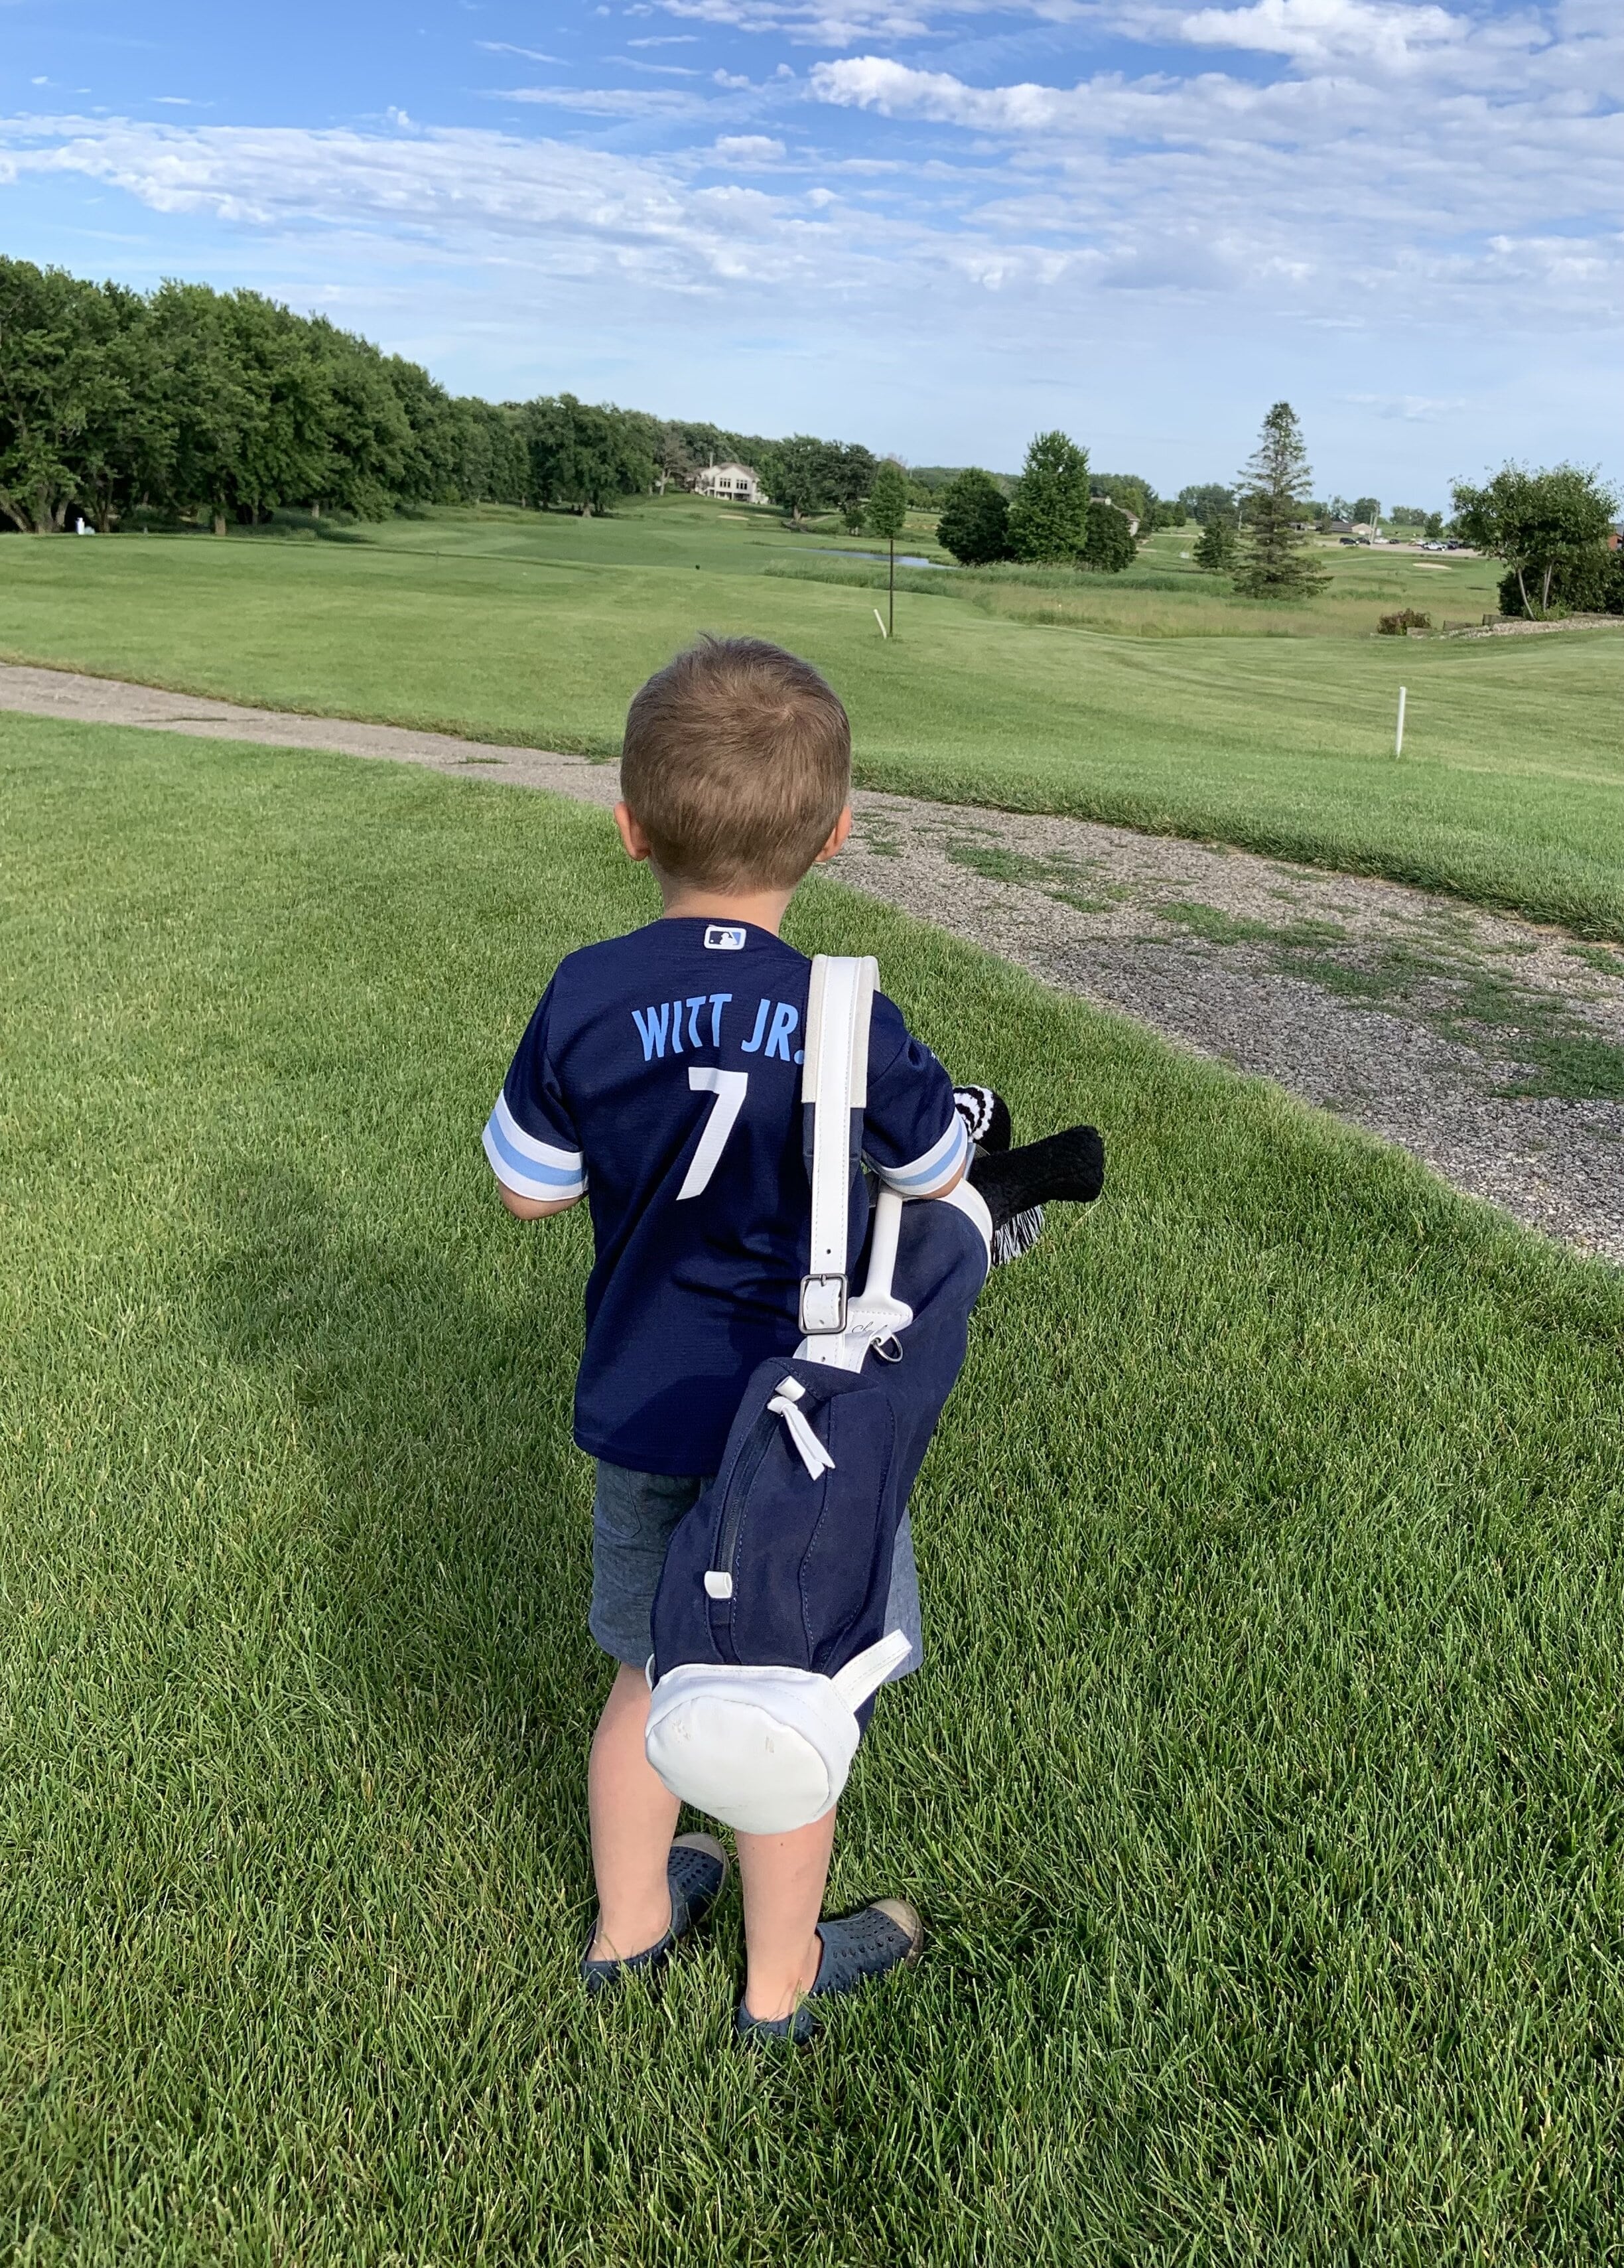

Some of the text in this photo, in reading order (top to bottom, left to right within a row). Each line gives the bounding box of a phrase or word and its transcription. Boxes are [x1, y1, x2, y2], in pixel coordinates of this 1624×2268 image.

[632, 993, 805, 1064] WITT JR.
[676, 1066, 748, 1200] 7
